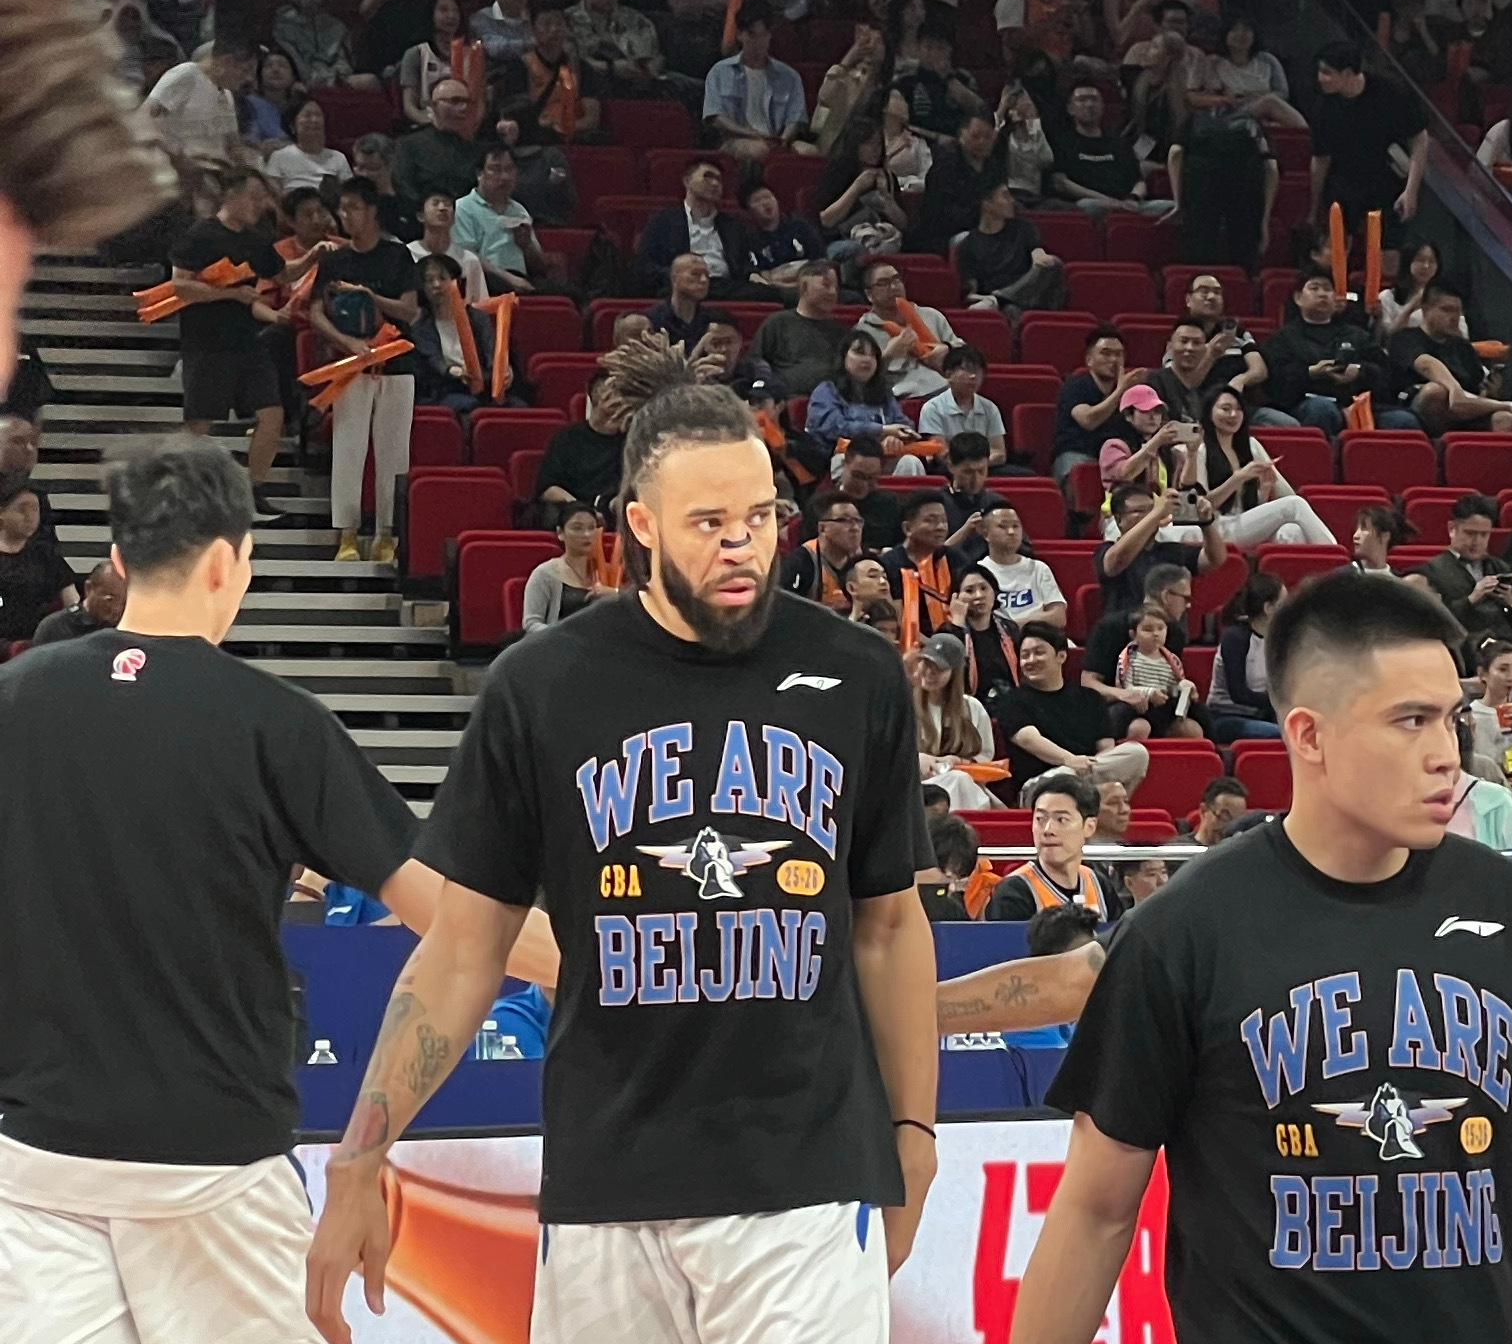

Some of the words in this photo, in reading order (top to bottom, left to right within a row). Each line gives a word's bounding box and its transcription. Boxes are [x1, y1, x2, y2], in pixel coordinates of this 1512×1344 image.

[575, 722, 695, 854] WE
[710, 721, 845, 861] ARE
[599, 864, 643, 898] CBA
[594, 908, 826, 1007] BEIJING
[1240, 971, 1370, 1110] WE
[1276, 1123, 1320, 1157] CBA
[1268, 1168, 1503, 1272] BEIJING
